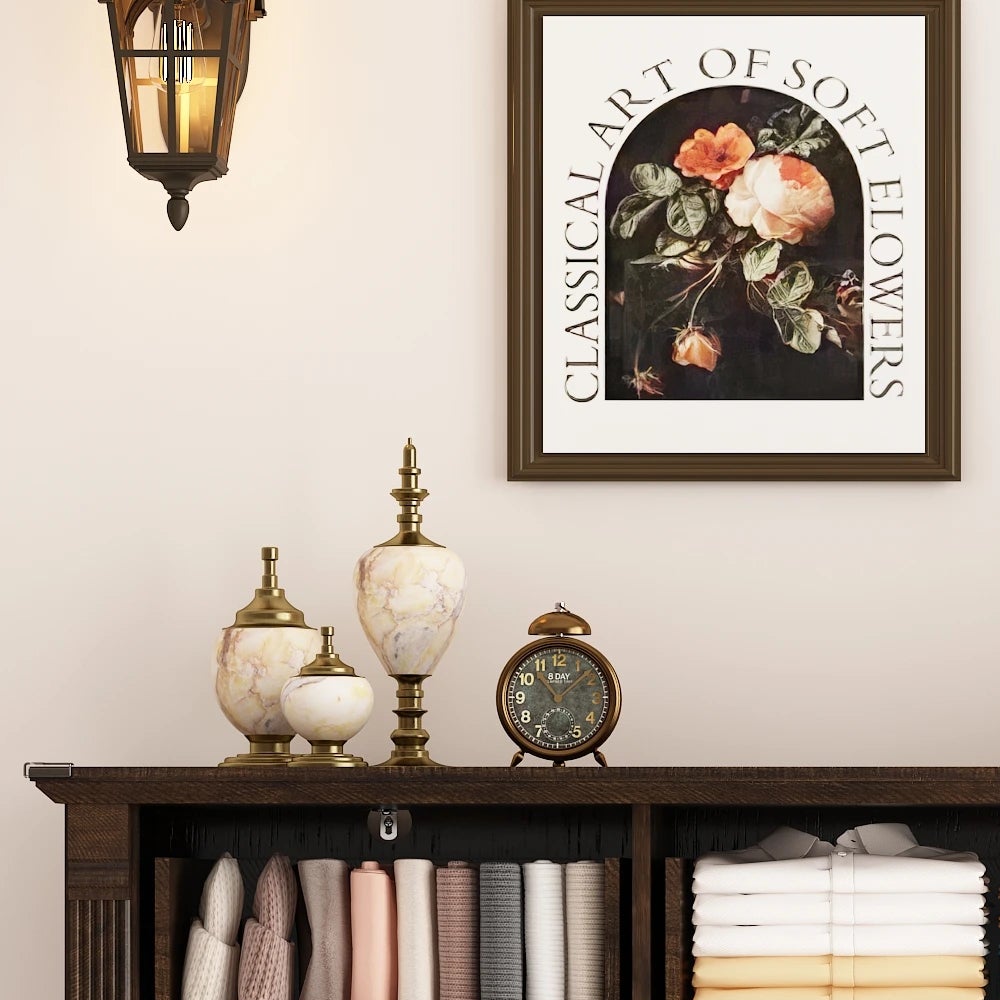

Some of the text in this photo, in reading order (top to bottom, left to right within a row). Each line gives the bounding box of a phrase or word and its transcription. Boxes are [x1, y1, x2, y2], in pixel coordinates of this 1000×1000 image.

[564, 162, 604, 402] CLASSICAL
[588, 59, 677, 150] ART
[698, 48, 771, 79] OF
[783, 58, 896, 158] SOFT
[535, 658, 546, 671] 11
[552, 654, 567, 667] 12
[575, 660, 580, 672] 1
[519, 672, 534, 686] 10
[516, 691, 525, 704] 9
[592, 692, 601, 704] 3
[521, 710, 531, 723] 8
[586, 711, 595, 724] 4
[535, 725, 542, 738] 7
[572, 725, 582, 738] 5
